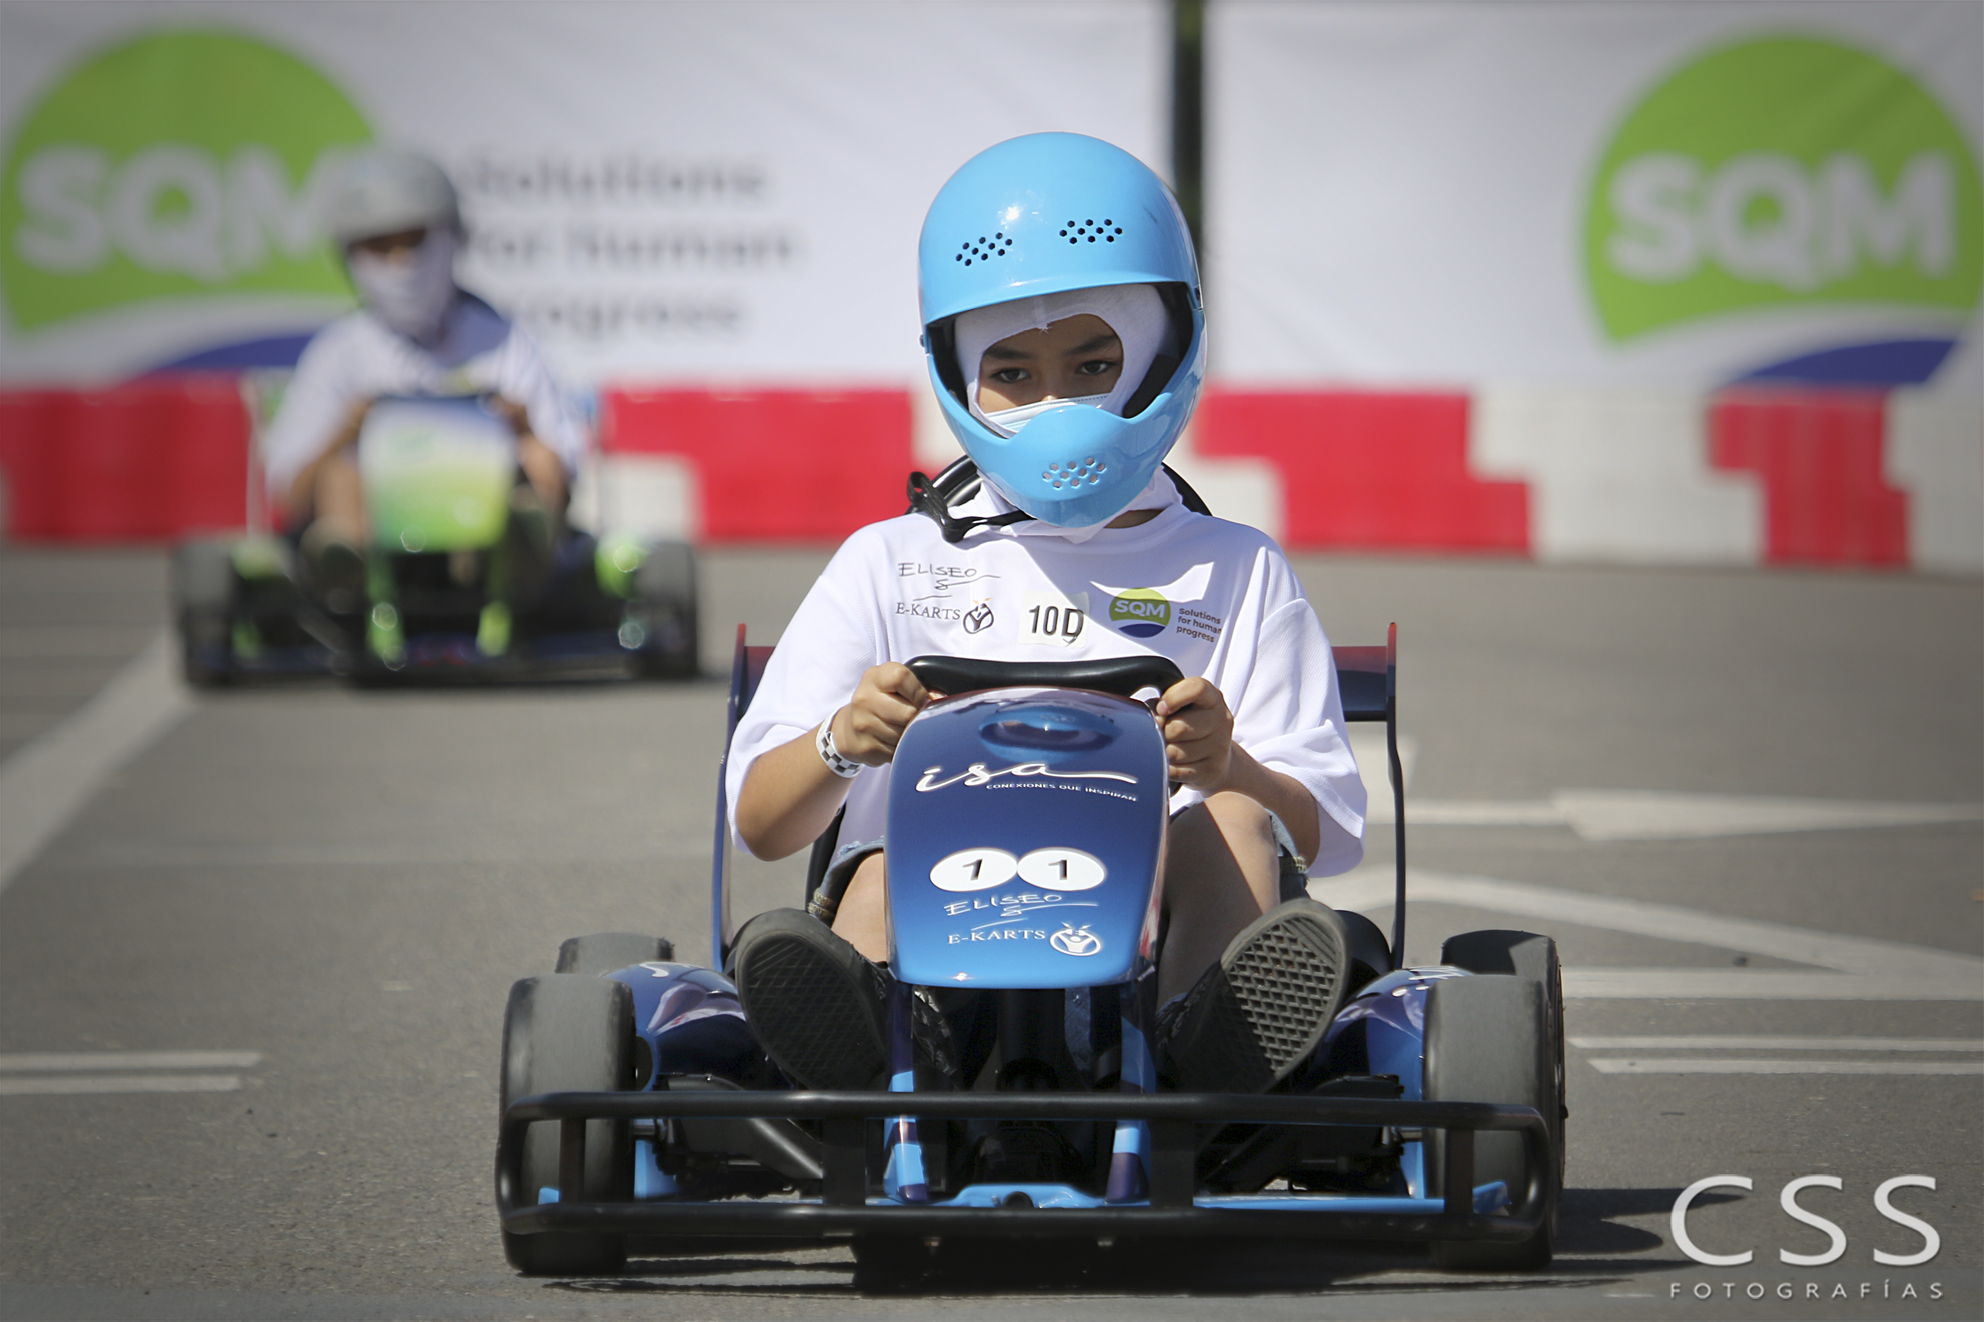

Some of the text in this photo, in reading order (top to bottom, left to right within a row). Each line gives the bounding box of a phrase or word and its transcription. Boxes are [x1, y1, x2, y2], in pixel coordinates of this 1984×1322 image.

[12, 142, 346, 281] SQM
[1606, 147, 1956, 293] SQM
[897, 562, 977, 578] ELISEO
[895, 602, 961, 621] E-KARTS
[1114, 599, 1166, 618] SQM
[1179, 608, 1221, 624] Solutions
[1177, 615, 1191, 625] for
[1176, 626, 1215, 642] progress
[915, 761, 1138, 792] isa
[1058, 783, 1082, 792] QUE
[1085, 787, 1137, 801] INSPIRAN
[943, 894, 1063, 916] ELISEO
[948, 929, 1047, 945] E-KARTS
